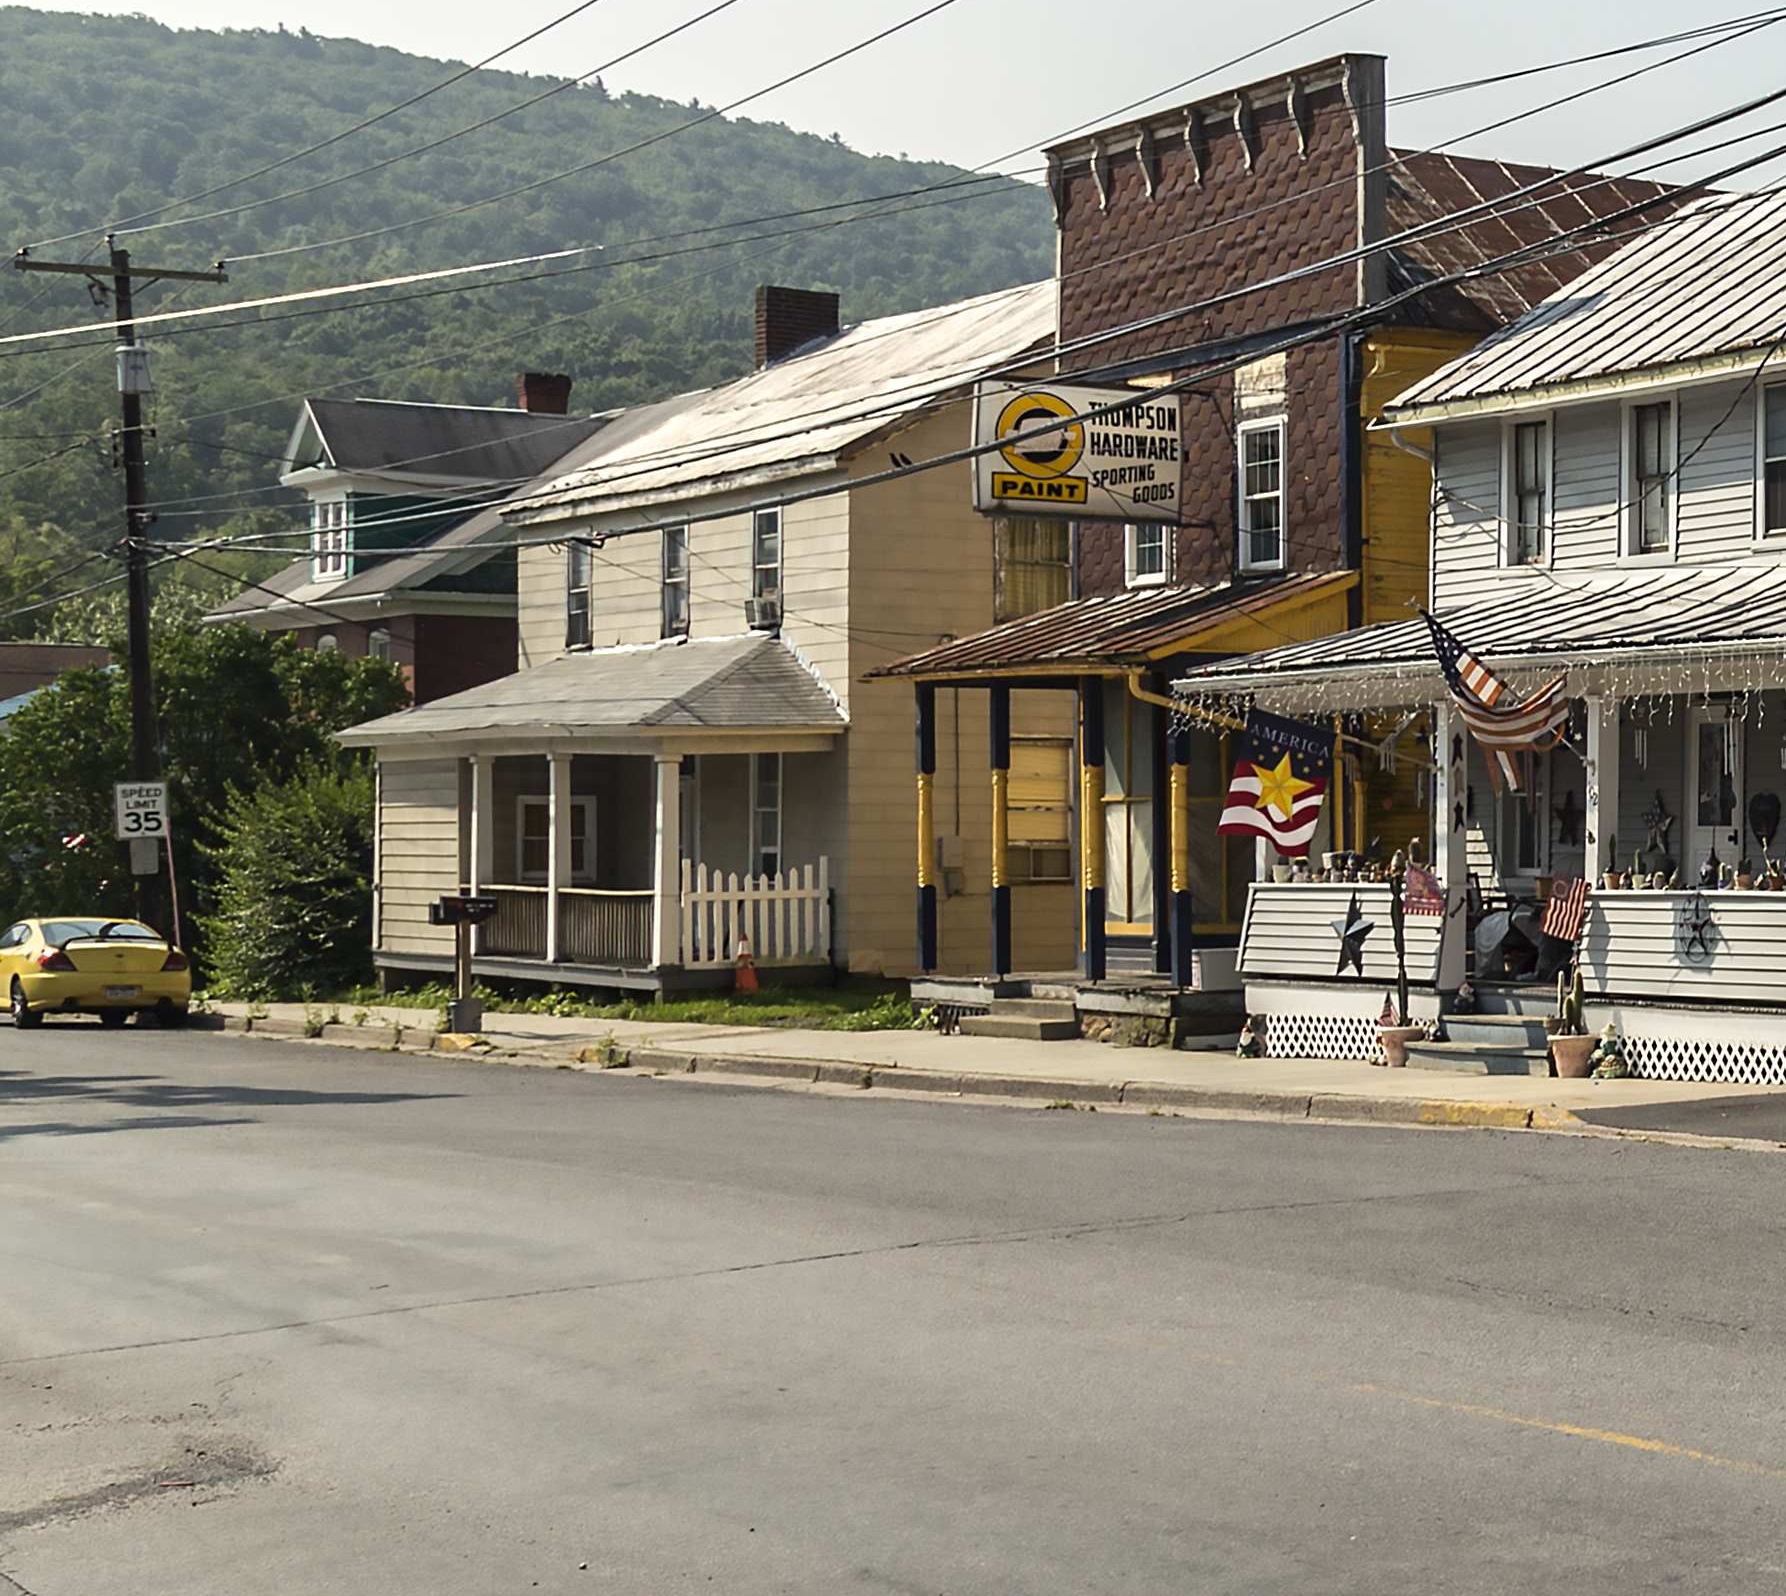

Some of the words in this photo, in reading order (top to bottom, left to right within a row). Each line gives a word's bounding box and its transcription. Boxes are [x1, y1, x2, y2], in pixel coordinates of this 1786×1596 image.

[1088, 401, 1177, 432] THOMPSON
[1090, 432, 1178, 461] HARDWARE
[1092, 464, 1155, 488] SPORTING
[1002, 481, 1080, 498] PAINT
[1132, 482, 1175, 504] GOODS
[1251, 724, 1329, 758] AMERICA
[121, 788, 162, 798] SPEED
[126, 800, 157, 809] LIMIT
[124, 811, 163, 832] 35
